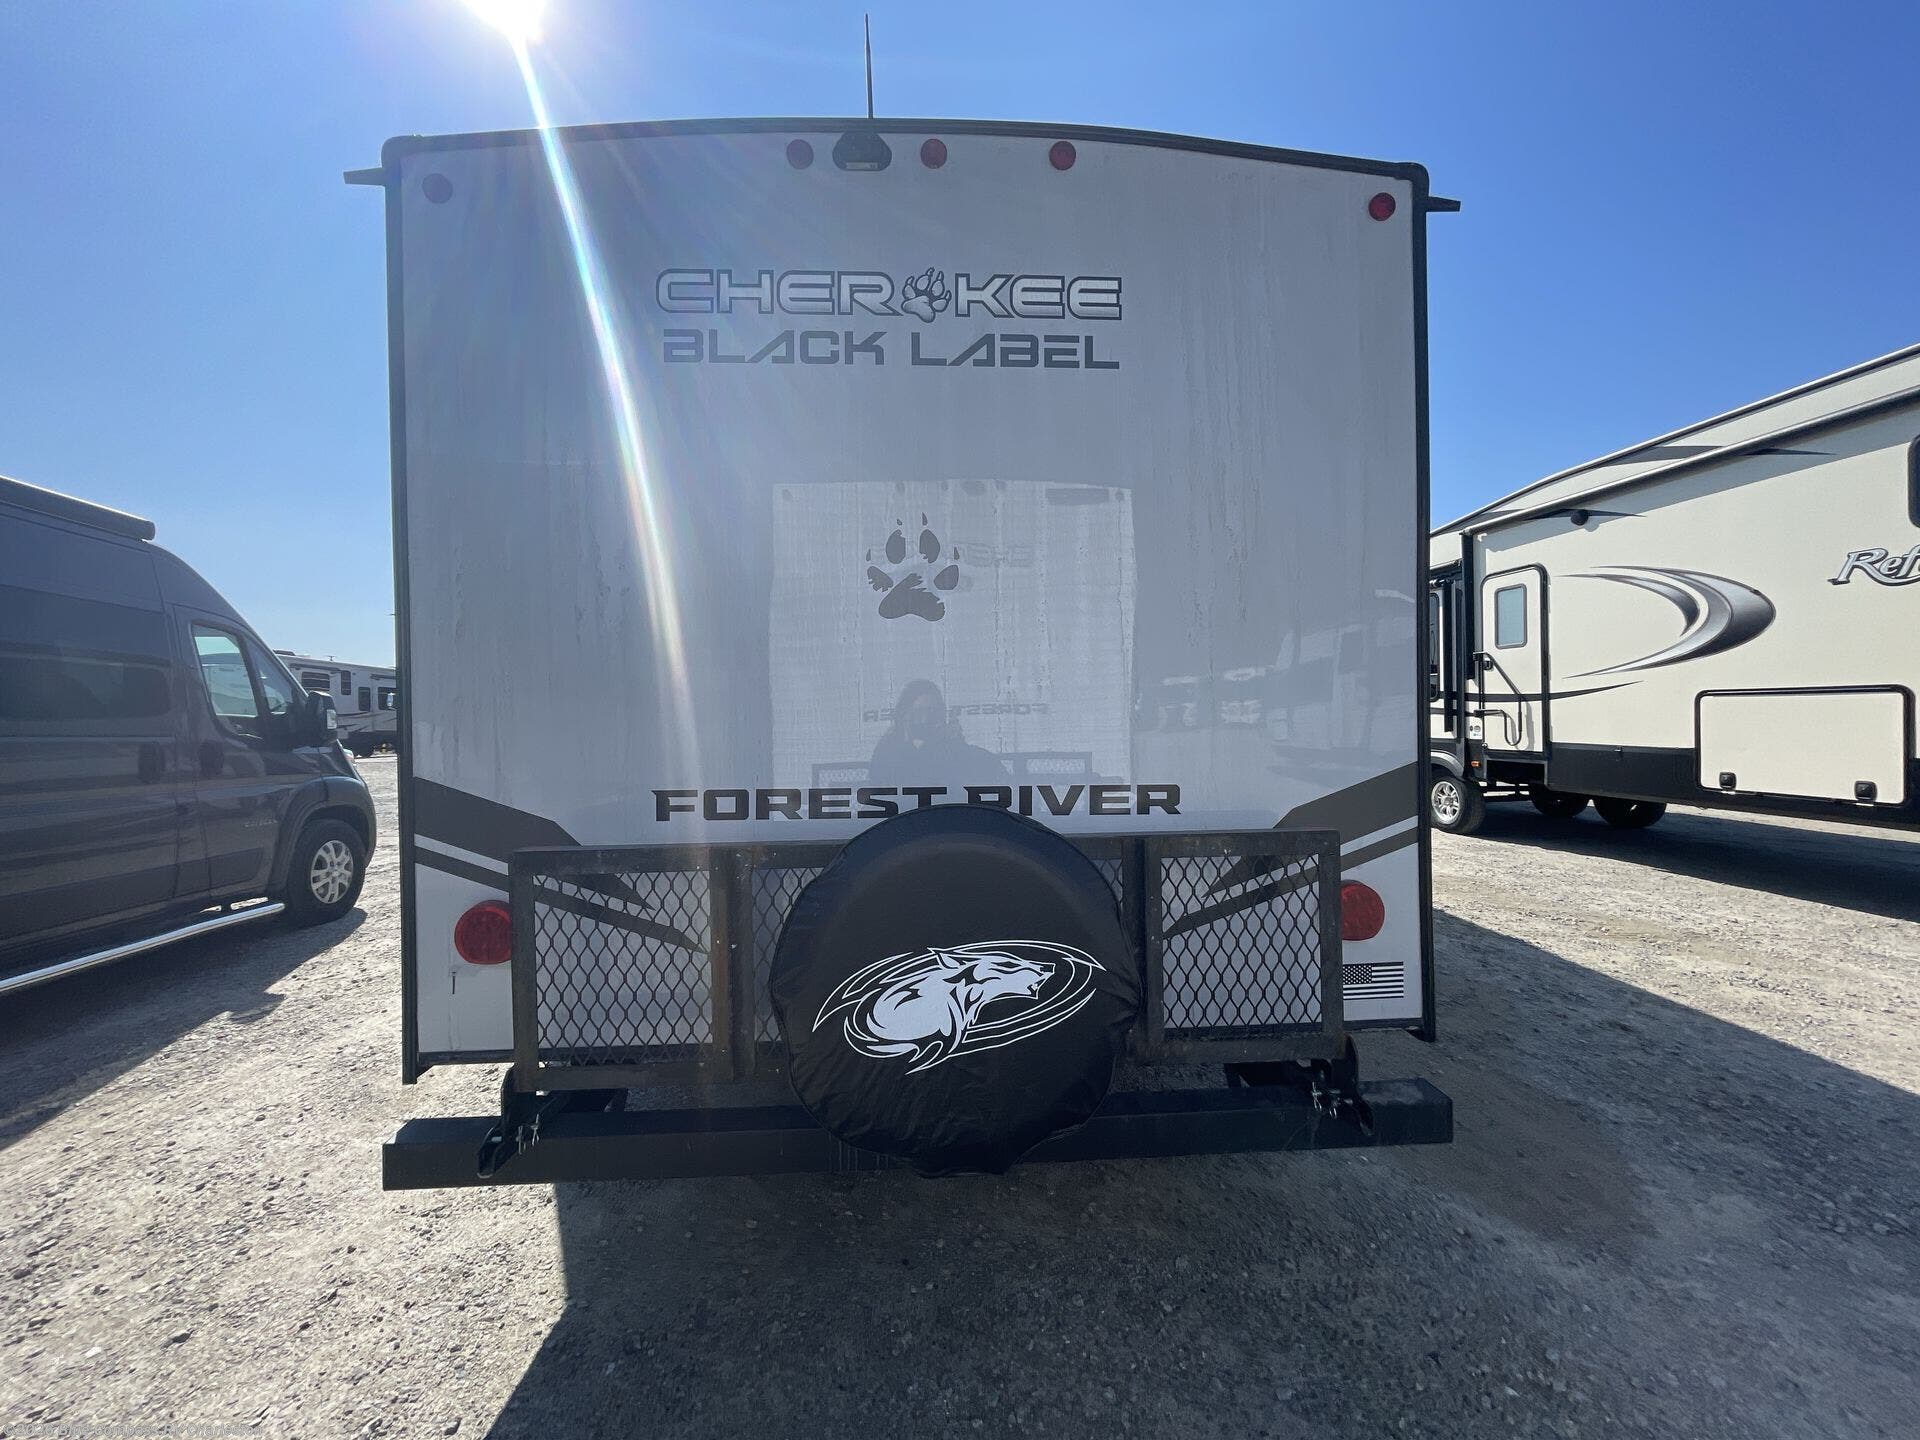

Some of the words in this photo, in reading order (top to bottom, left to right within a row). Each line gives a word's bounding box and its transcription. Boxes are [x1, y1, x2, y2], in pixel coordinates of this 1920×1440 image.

[663, 329, 887, 366] BLACK
[911, 332, 1120, 370] LABEL
[651, 787, 947, 822] FOREST
[964, 784, 1182, 816] RIVER
